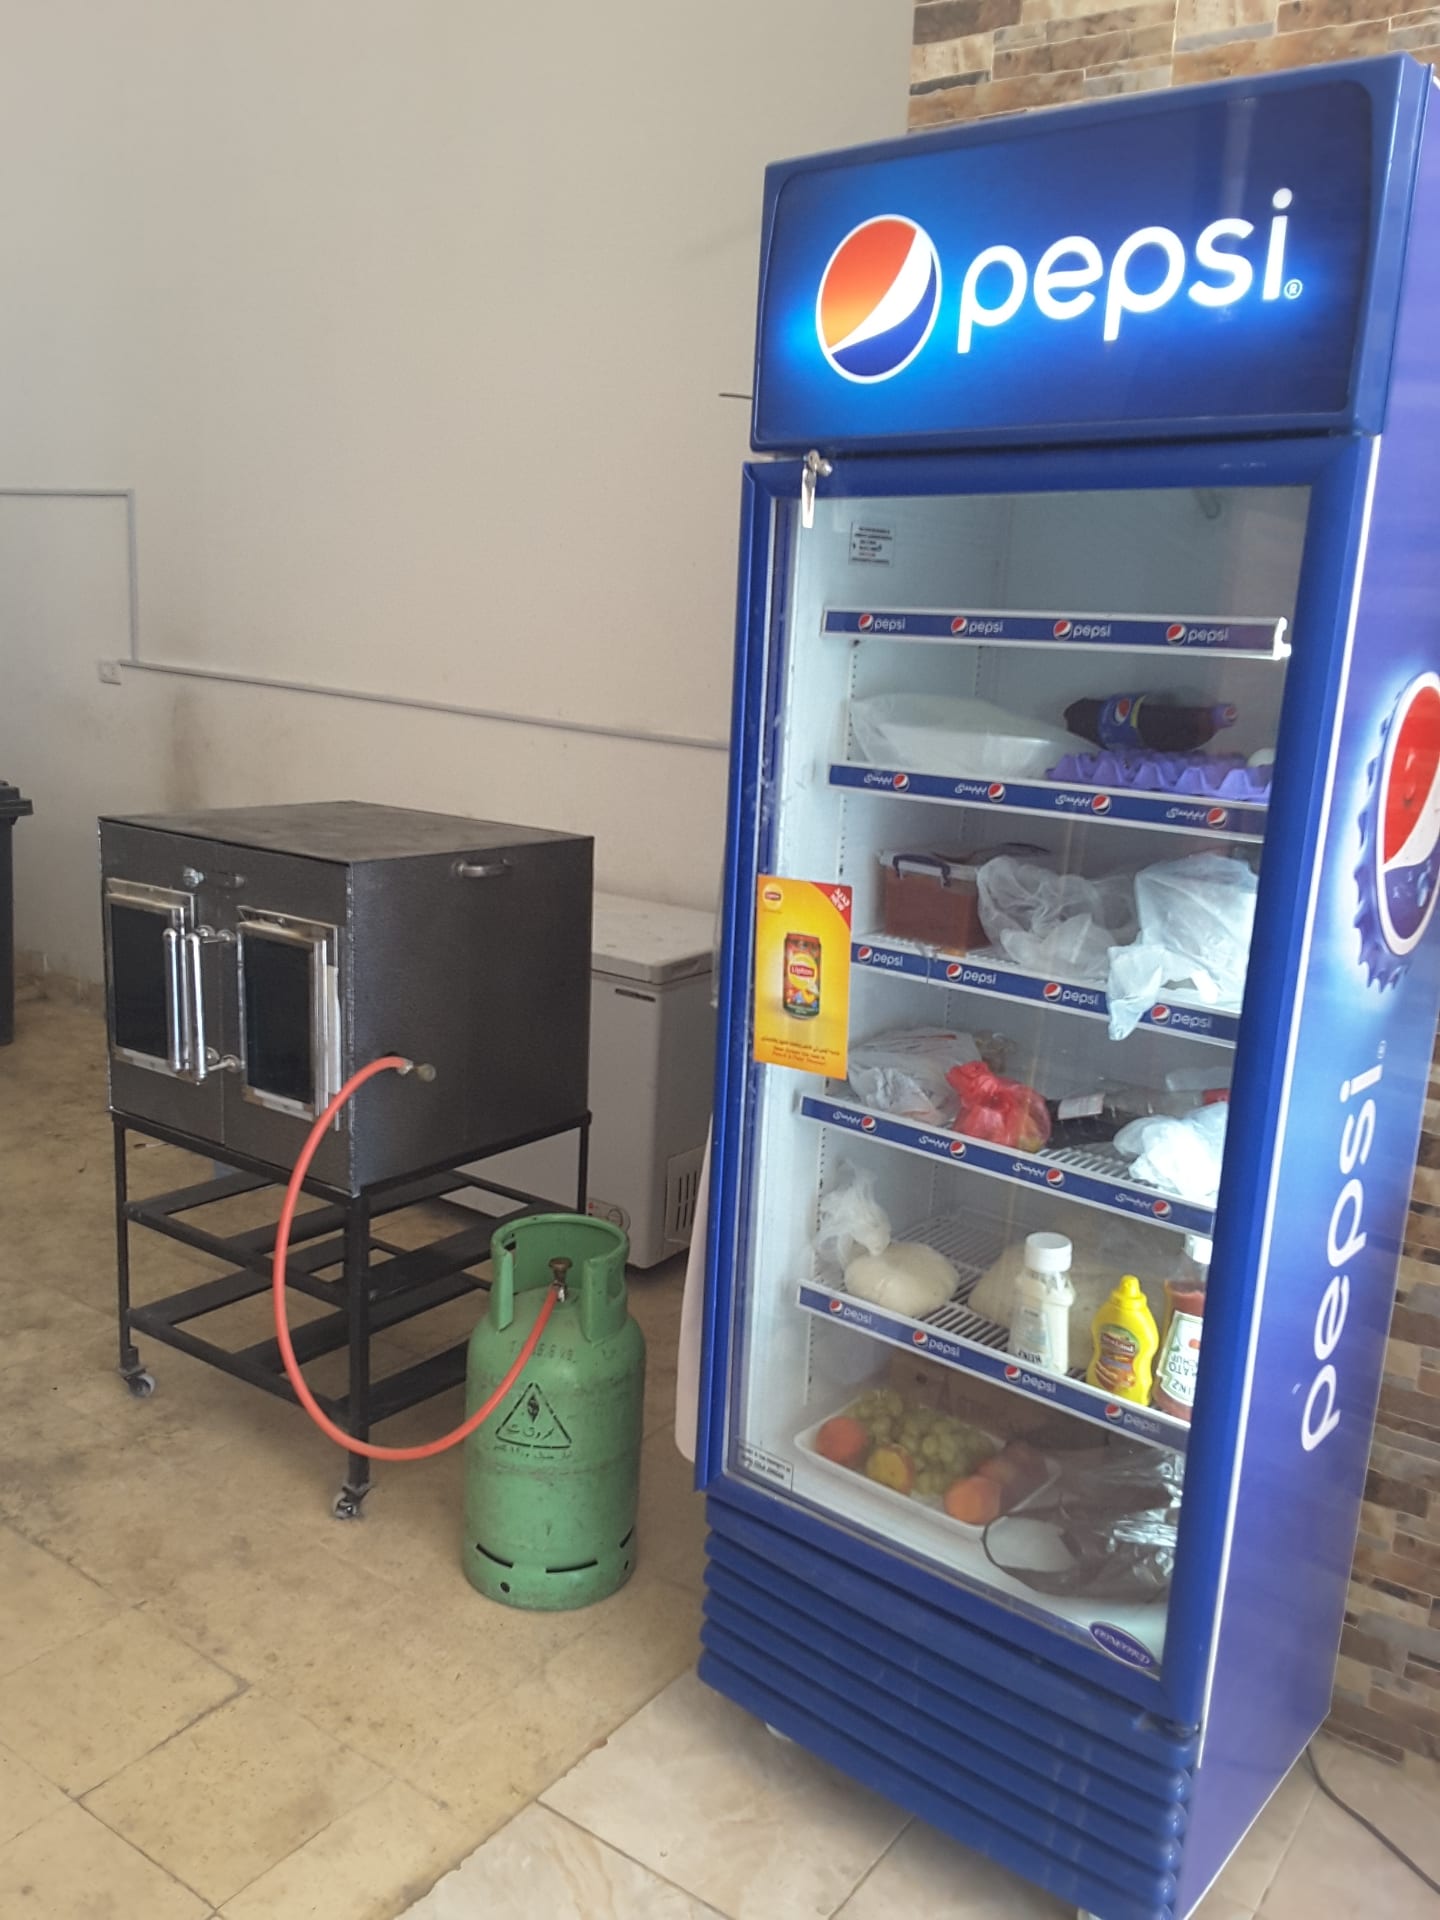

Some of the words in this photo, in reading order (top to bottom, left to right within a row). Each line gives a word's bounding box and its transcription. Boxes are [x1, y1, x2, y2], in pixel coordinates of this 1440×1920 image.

[957, 187, 1293, 354] pepsi
[874, 617, 906, 633] pepsi
[968, 621, 1003, 636] pepsi
[1072, 624, 1111, 639] pepsi
[1187, 628, 1229, 644] pepsi
[873, 952, 904, 968] pepsi
[962, 969, 997, 986] pepsi
[1062, 989, 1099, 1006] pepsi
[1170, 1011, 1212, 1029] pepsi
[1301, 1063, 1384, 1452] pepsi
[843, 1306, 873, 1325] pepsi
[928, 1338, 961, 1358] pepsi
[1022, 1373, 1057, 1394] pepsi
[1123, 1412, 1162, 1436] pepsi
